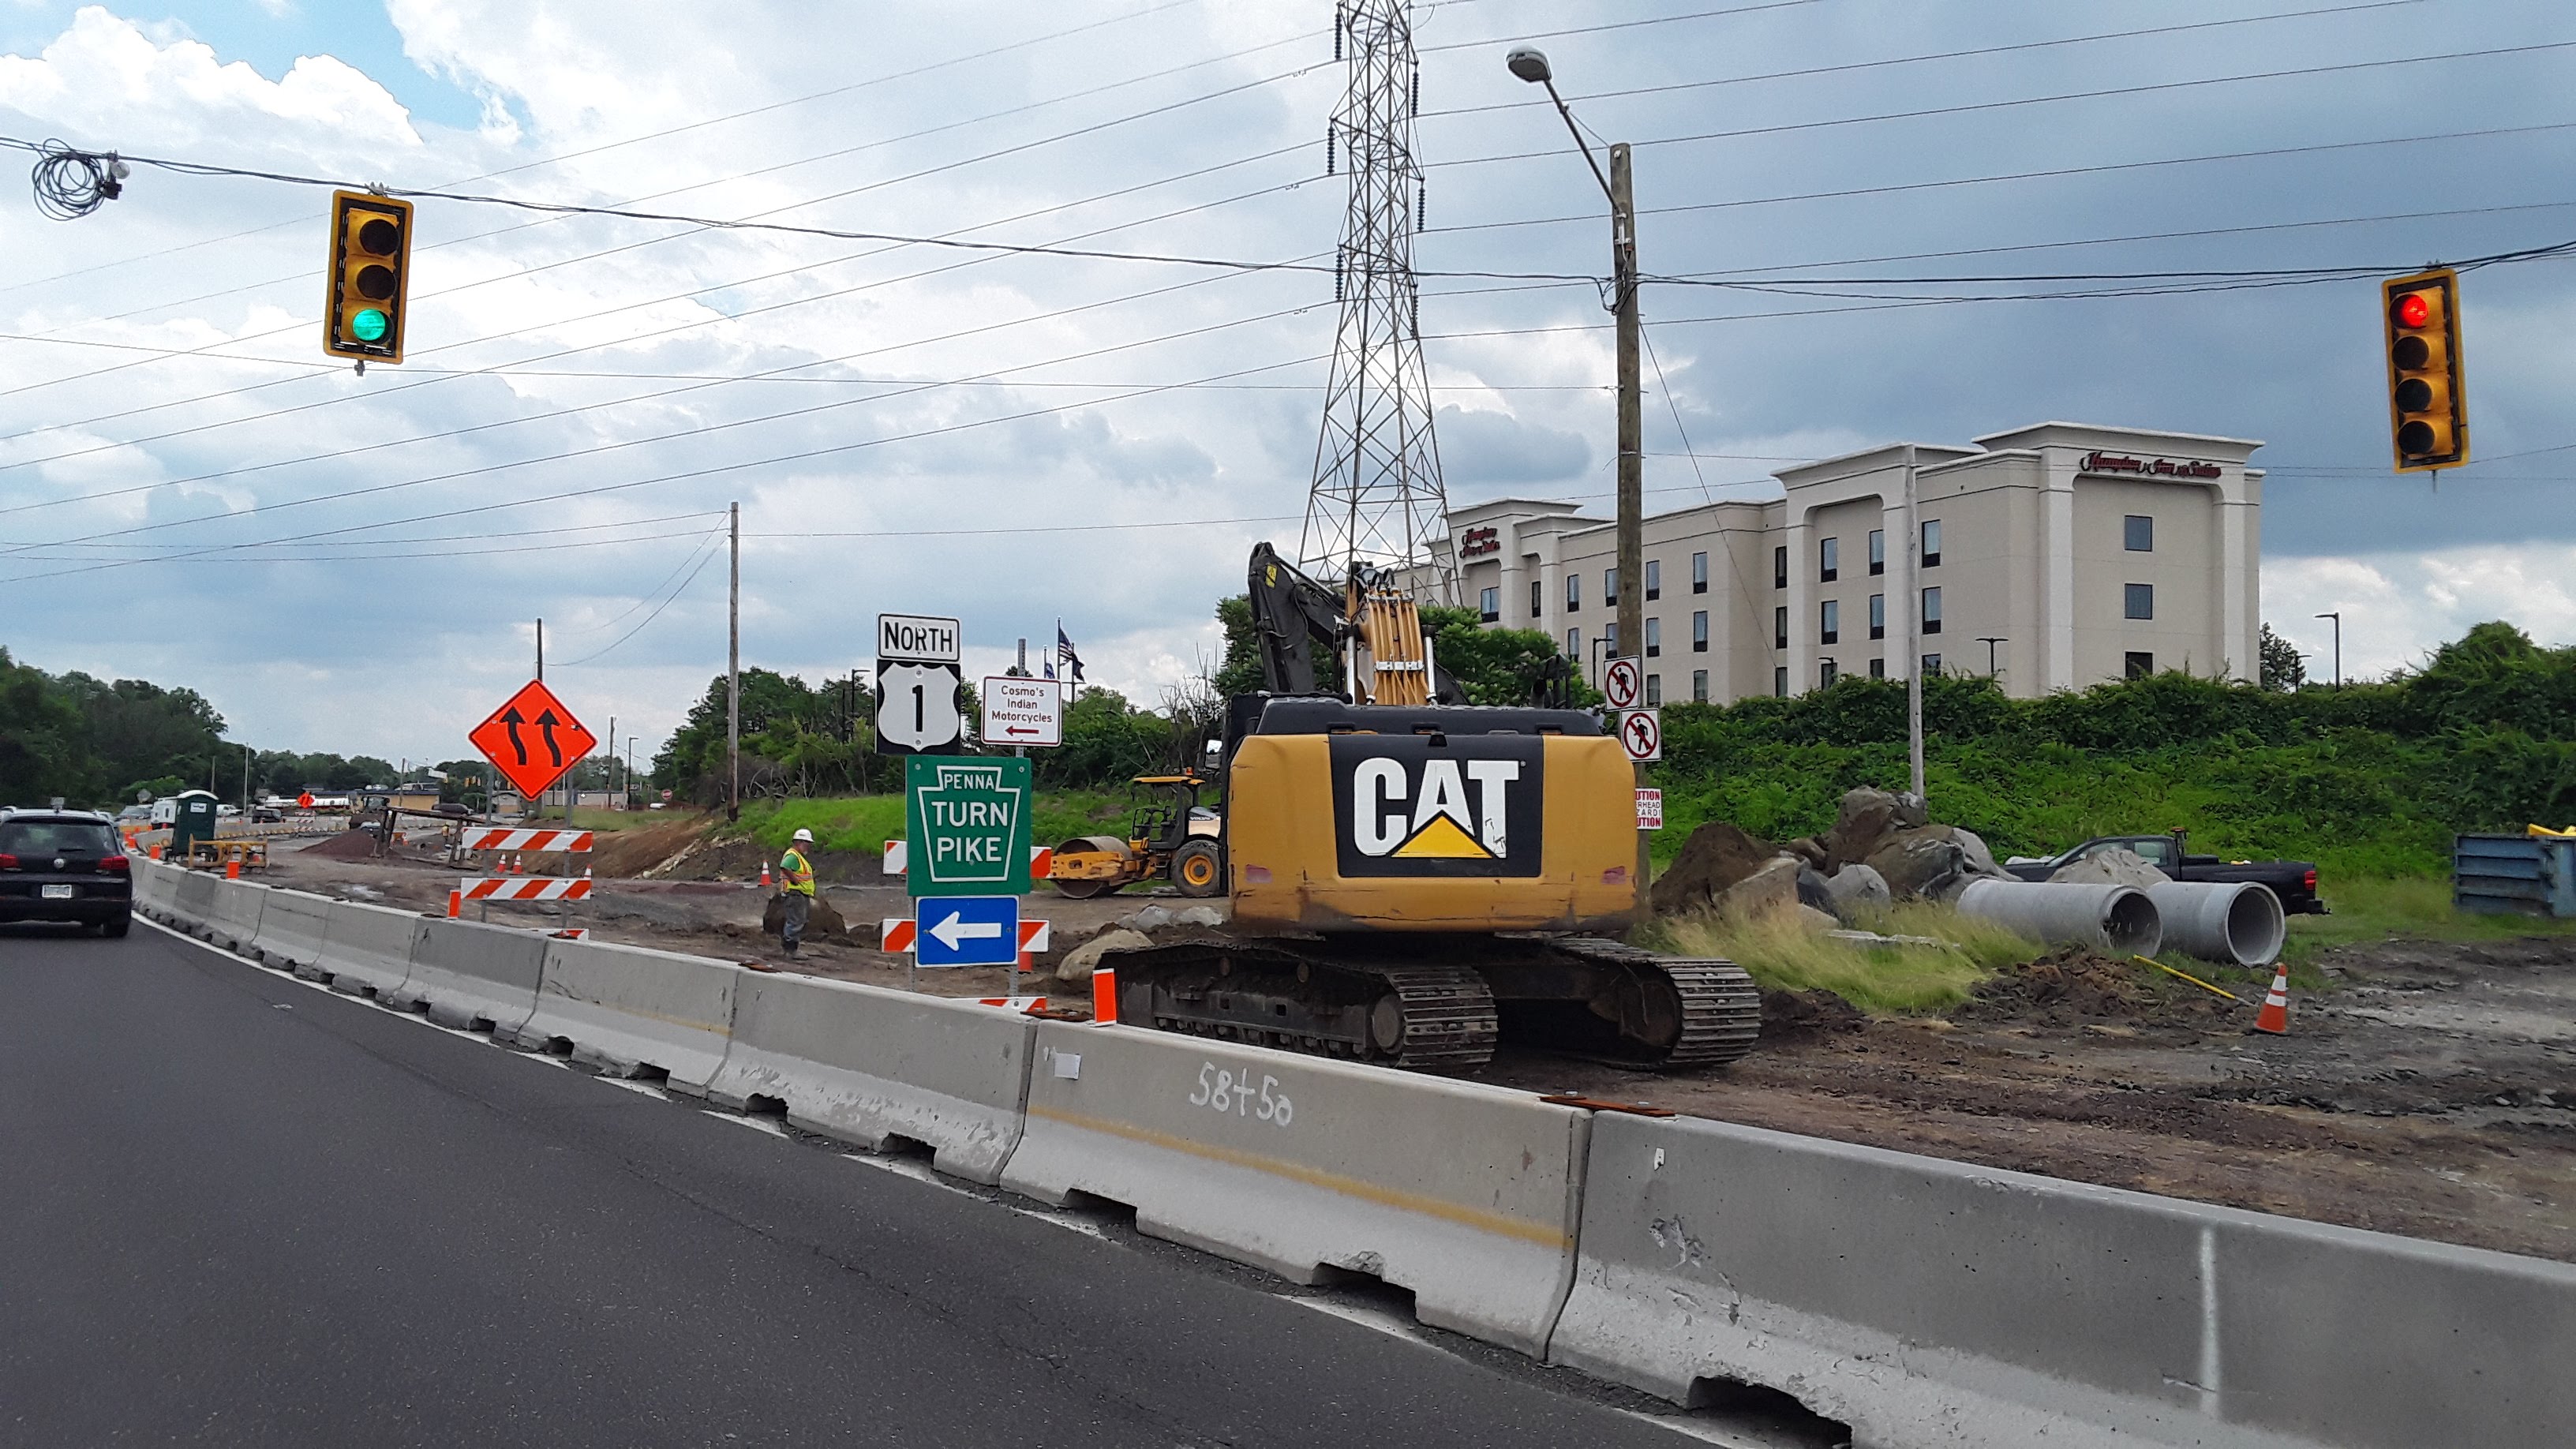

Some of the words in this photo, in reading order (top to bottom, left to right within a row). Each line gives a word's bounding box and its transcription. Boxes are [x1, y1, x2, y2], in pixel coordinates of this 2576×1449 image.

[884, 621, 953, 653] NORTH
[1001, 685, 1045, 698] Cosmo's
[912, 684, 923, 732] 1
[1007, 698, 1038, 710] Indian
[991, 710, 1053, 724] Motorcycles
[944, 773, 994, 789] PENNA
[1635, 790, 1661, 801] UTION
[930, 801, 1009, 827] TURN
[1354, 757, 1520, 859] CAT
[1637, 817, 1661, 827] UTION
[937, 837, 1002, 862] PIKE
